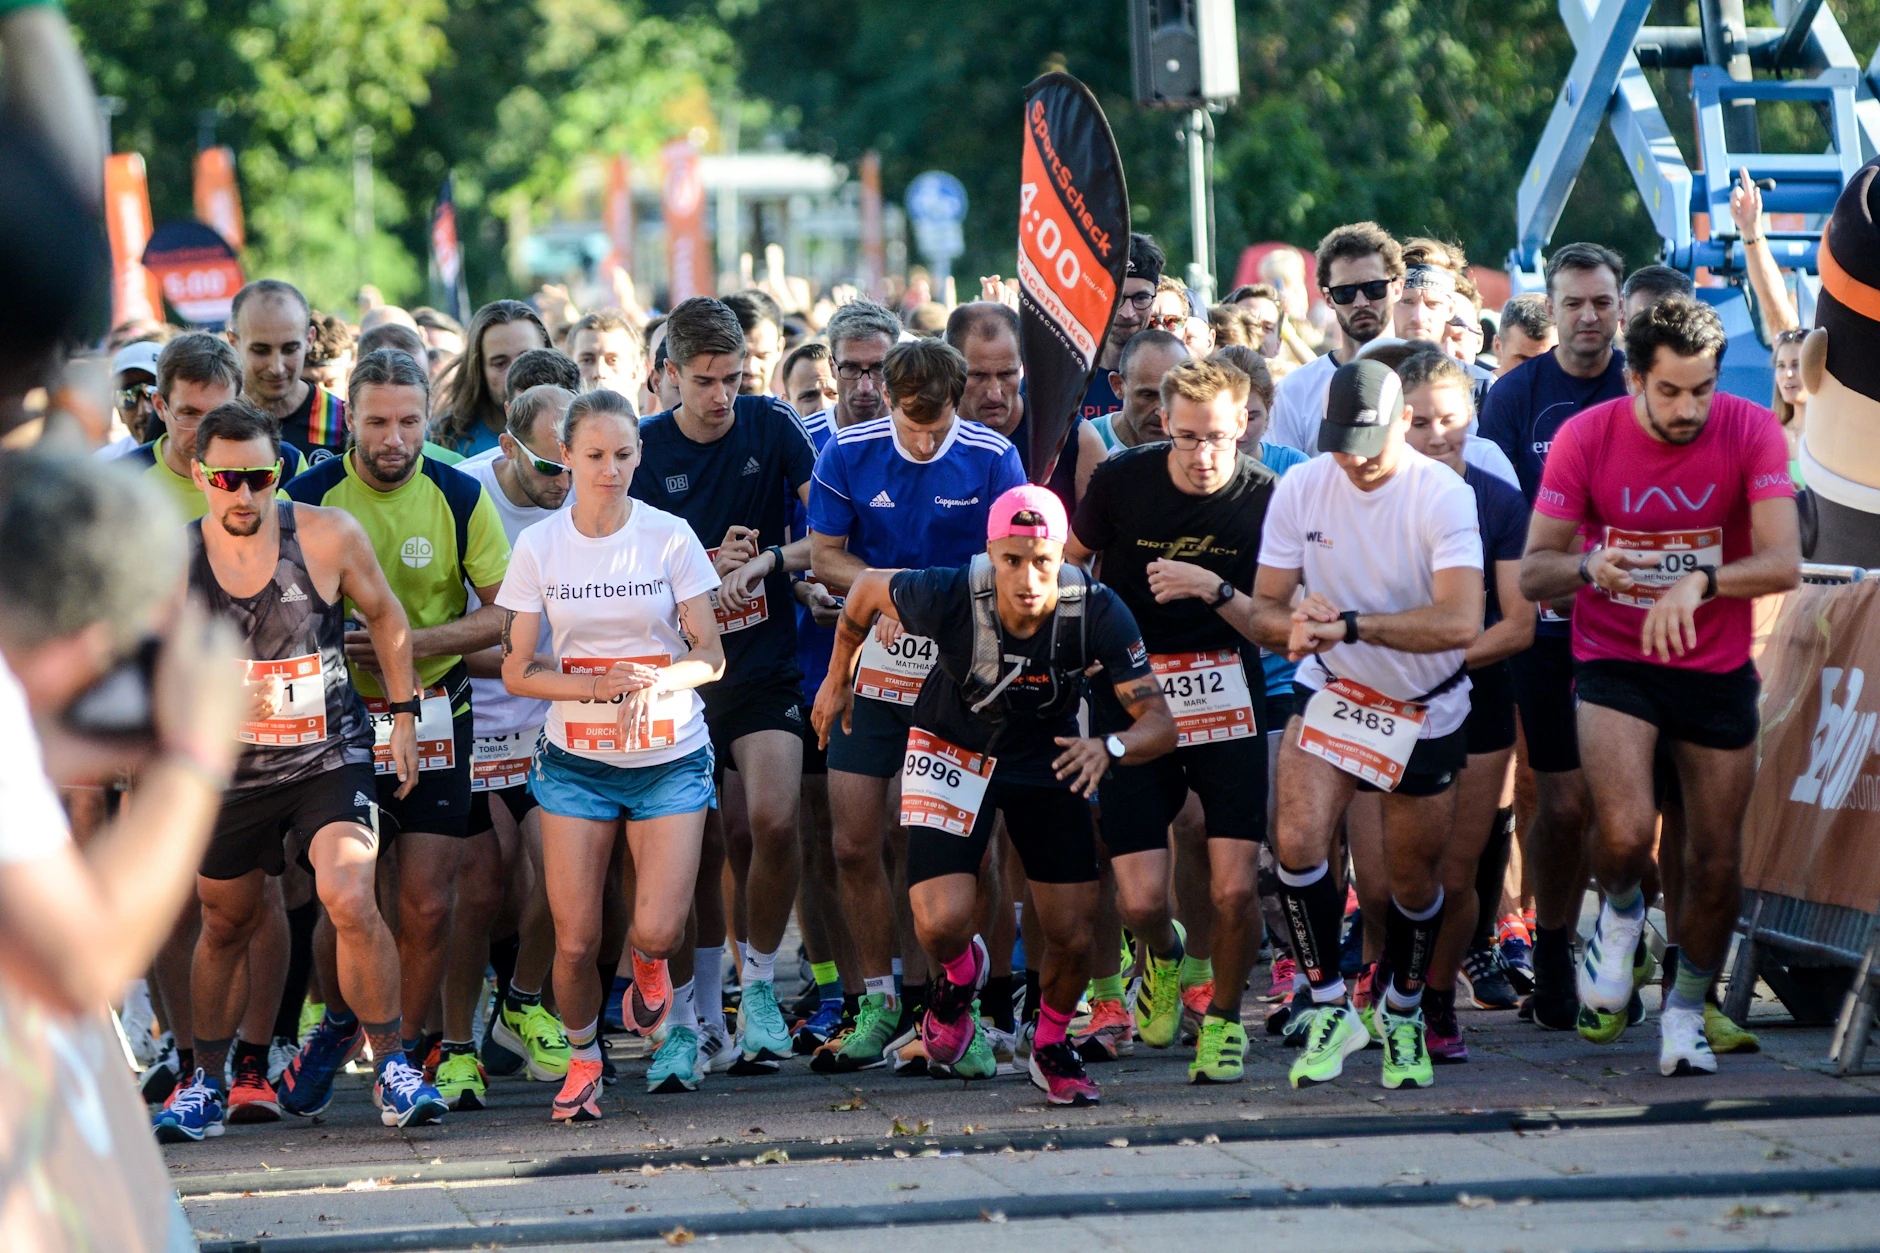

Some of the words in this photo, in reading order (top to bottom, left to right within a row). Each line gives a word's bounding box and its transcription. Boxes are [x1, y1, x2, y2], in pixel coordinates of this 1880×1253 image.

[1031, 100, 1112, 258] SportScheck
[1019, 291, 1087, 372] PORTSCHECK.COM
[668, 477, 687, 490] DB
[934, 496, 971, 509] Capgemini
[1623, 483, 1717, 513] IAV
[1644, 573, 1684, 581] HENDRIC
[545, 579, 664, 600] #läuftbeimir
[280, 593, 309, 604] adidas
[750, 600, 759, 610] D
[1163, 672, 1226, 699] 4312
[1183, 698, 1208, 708] MARK
[1176, 720, 1200, 728] ARTZEIT
[1216, 715, 1227, 723] Uhr
[1236, 710, 1246, 721] D
[1333, 700, 1397, 737] 2483
[307, 718, 317, 728] D
[435, 742, 445, 753] D
[478, 744, 509, 754] TOBIAS
[474, 764, 498, 773] ARTZEIT
[906, 753, 963, 789] 9996
[1388, 762, 1398, 774] D
[957, 810, 967, 820] D
